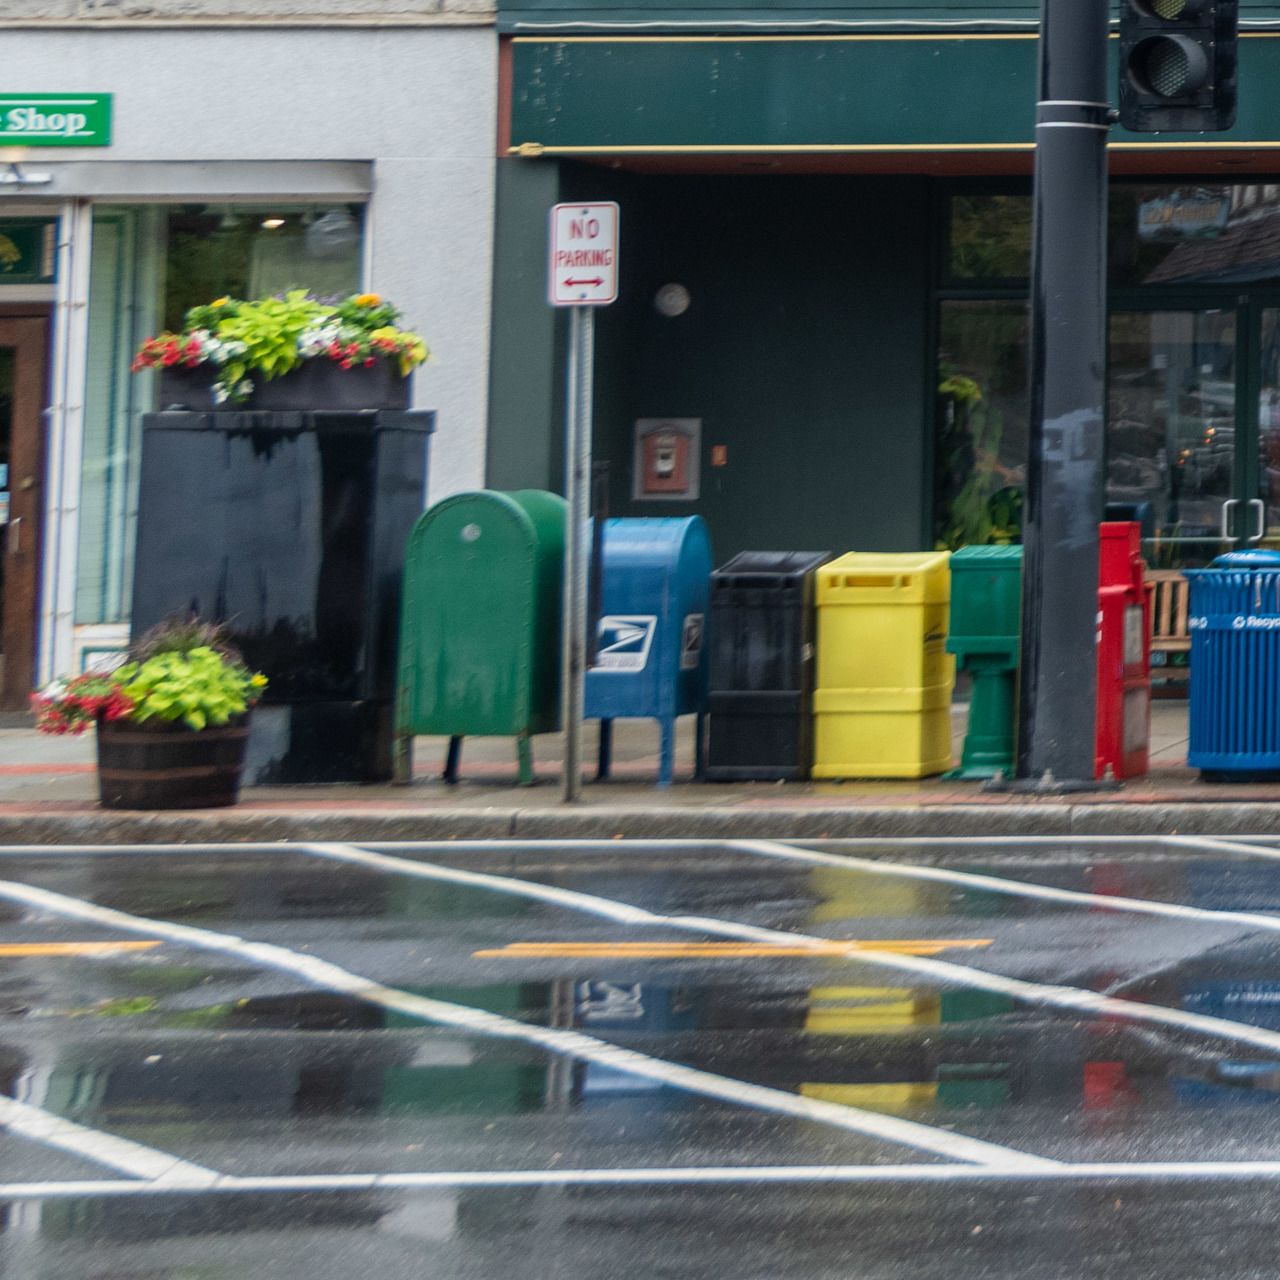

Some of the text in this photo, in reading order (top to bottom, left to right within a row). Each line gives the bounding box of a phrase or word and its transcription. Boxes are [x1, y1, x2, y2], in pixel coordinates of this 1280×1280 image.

[6, 107, 87, 137] Shop
[569, 218, 600, 239] NO
[558, 248, 612, 268] PARKING
